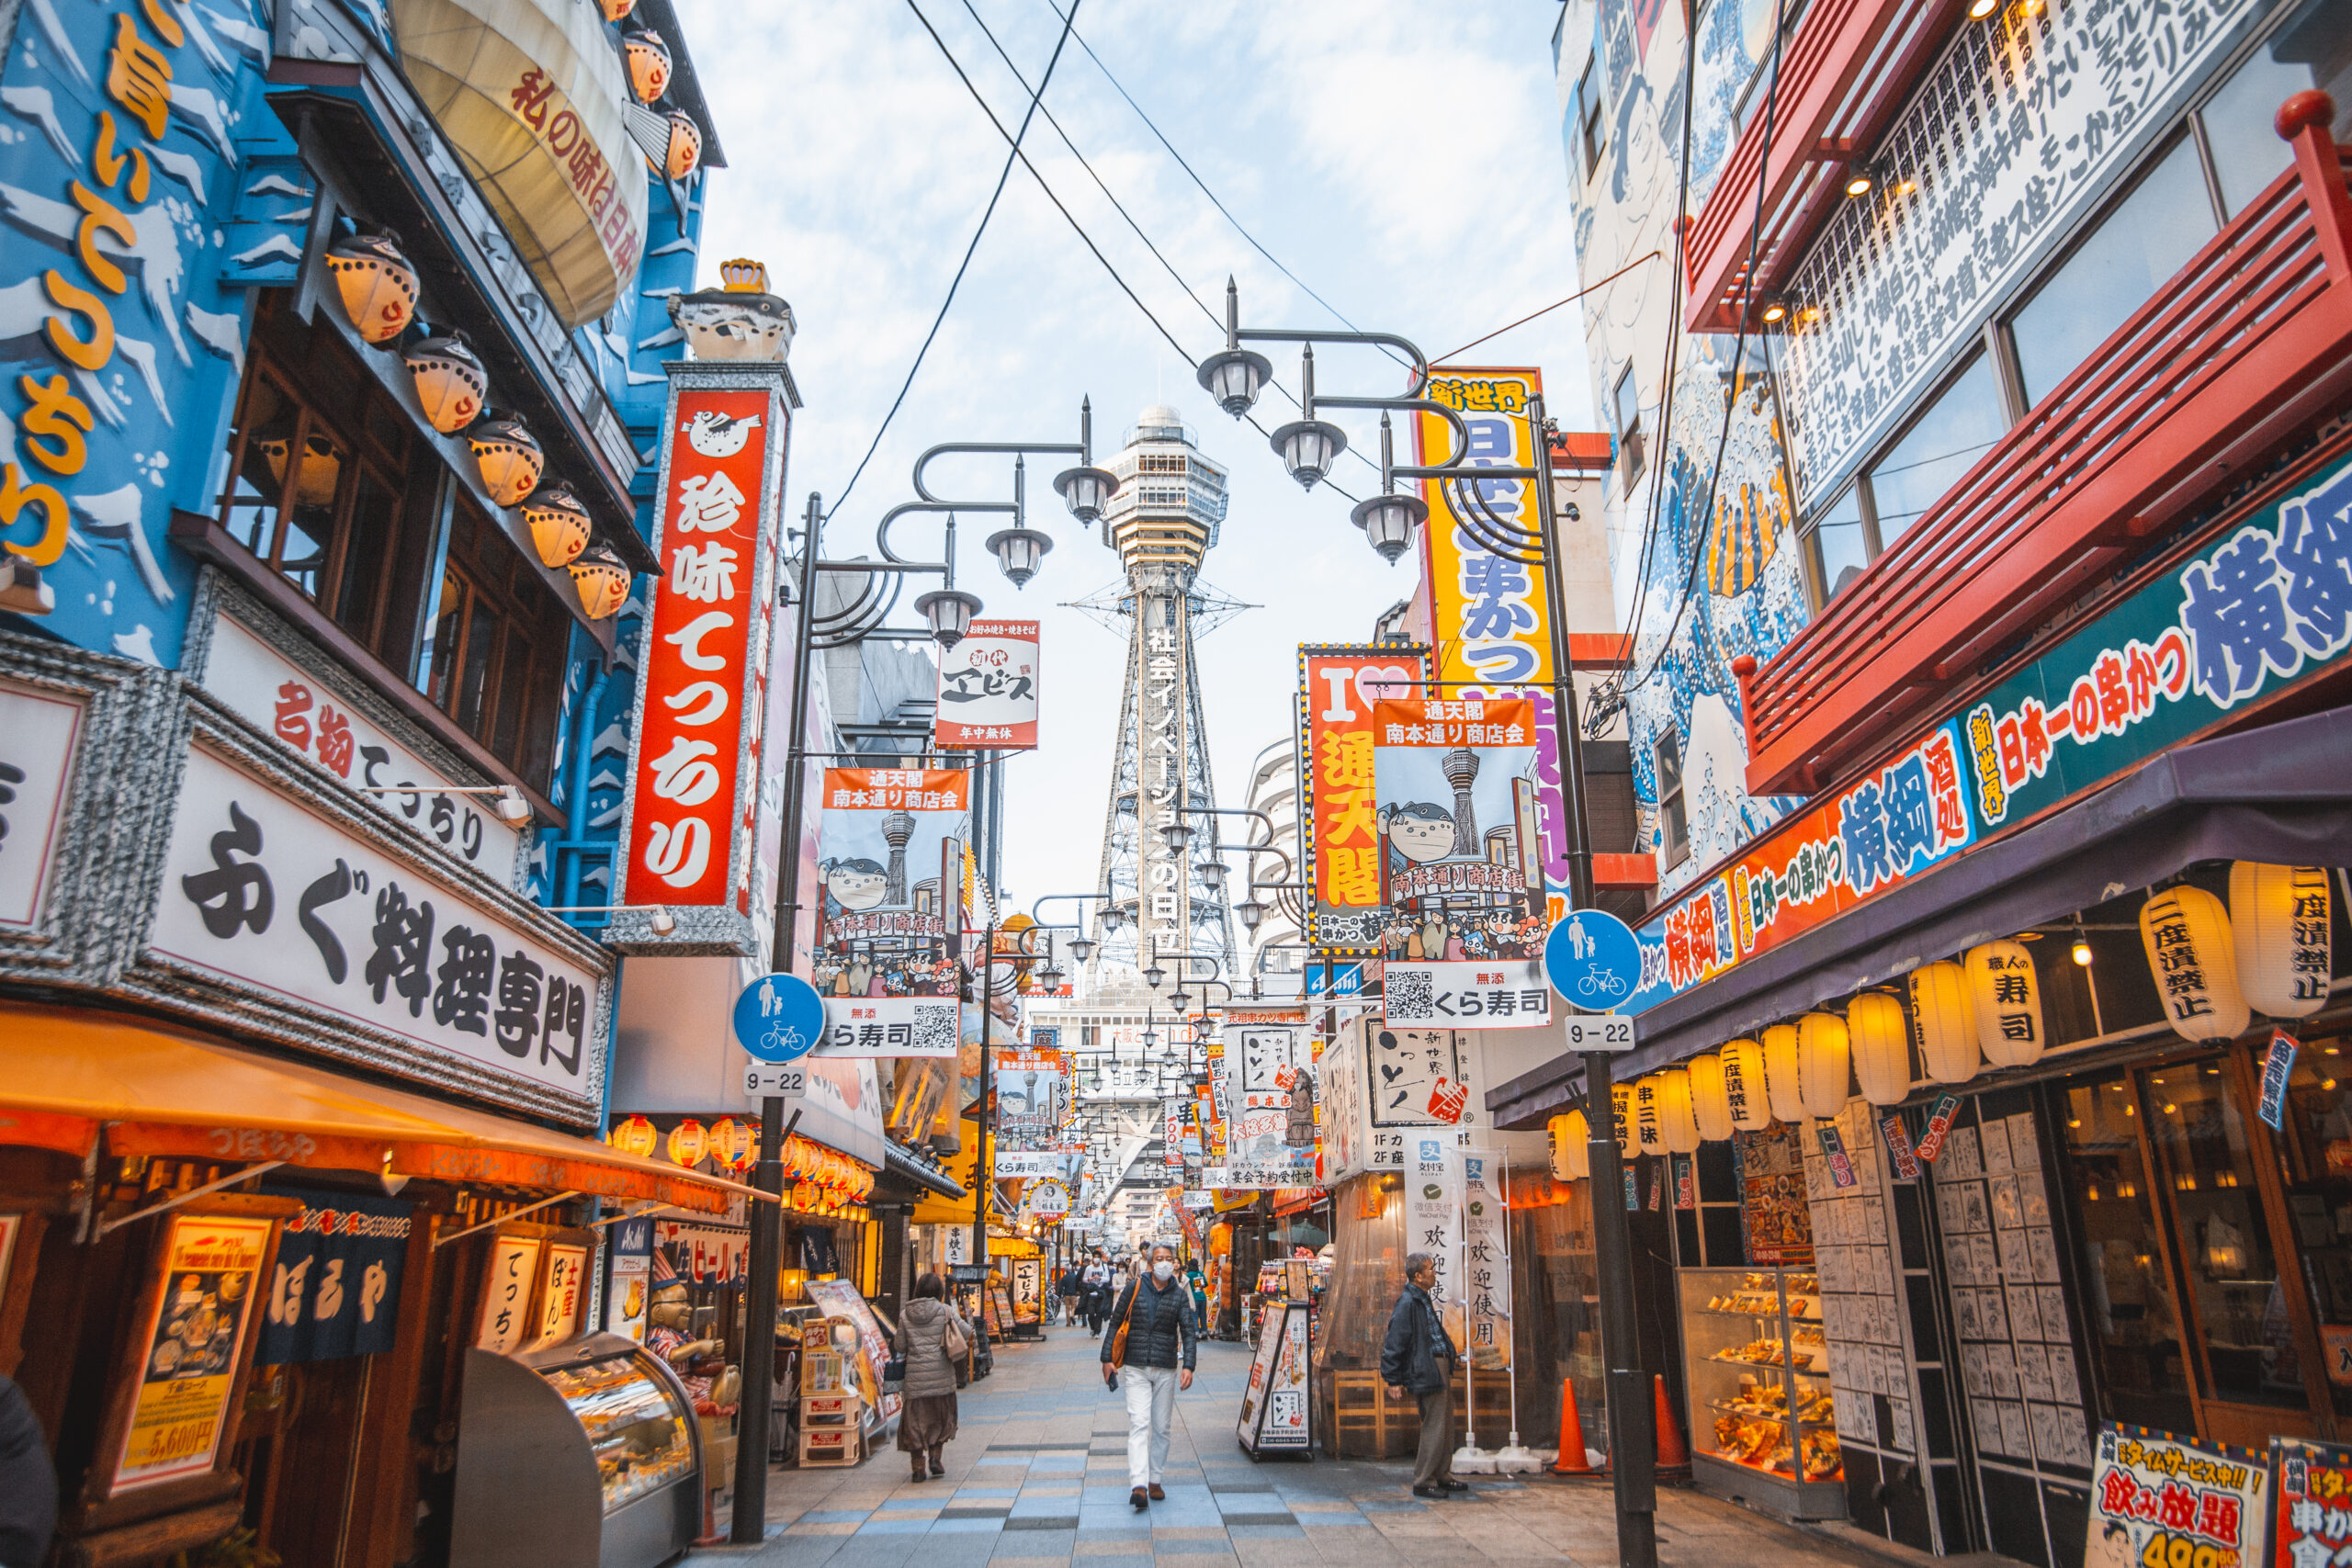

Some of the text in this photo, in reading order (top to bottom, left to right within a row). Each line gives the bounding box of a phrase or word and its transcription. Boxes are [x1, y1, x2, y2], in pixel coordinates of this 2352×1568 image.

[2043, 47, 2088, 188] たこ
[2064, 20, 2111, 164] いか
[2007, 95, 2050, 231] 貝柱
[2024, 71, 2067, 210] サーモン
[1957, 163, 1995, 293] かぼちゃ
[1973, 141, 2012, 276] 海老
[1991, 118, 2030, 251] キス
[1915, 223, 1946, 345] じゃが芋
[1928, 204, 1962, 328] 茄子
[1943, 186, 1977, 310] 椎茸
[1874, 277, 1904, 392] 銀杏
[1887, 261, 1917, 378] 白ねぎ
[1900, 242, 1932, 362] さつま芋
[1838, 325, 1865, 434] 山芋
[1850, 310, 1878, 420] しし唐
[1862, 294, 1891, 406] れんこん
[1430, 379, 1528, 413] 新世界
[1796, 384, 1820, 484] うずら玉子
[1806, 370, 1831, 472] 紅しょうが
[1817, 358, 1842, 461] にんにく
[1827, 341, 1852, 447] 玉ねぎ
[941, 668, 1035, 703] エビス
[1424, 701, 1484, 720] 通天閣
[1972, 709, 2006, 819] 新世界
[1997, 632, 2187, 788] 日本一の串かつ
[959, 727, 1012, 739] 年中無休
[1385, 723, 1524, 744] 南本通り商店会
[833, 789, 957, 808] 南本通り商店会
[869, 770, 923, 787] 通天閣
[1394, 867, 1525, 892] 南本通り商店街
[1736, 728, 1967, 950] 新世界 日本一の串かつ 横綱 酒処
[181, 800, 588, 1077] ふぐ料理専門
[829, 913, 944, 936] 南本通り商店街
[1320, 917, 1359, 926] 日本一の
[1320, 928, 1359, 941] 串かつ
[1665, 891, 1717, 987] 横綱
[1987, 955, 2029, 971] 職人の
[2148, 899, 2215, 1021] 二度漬禁止
[2291, 866, 2330, 1002] 二度漬禁止
[851, 1009, 876, 1019] 無添
[1227, 1012, 1306, 1023] 元祖串カツ専門店
[1434, 988, 1548, 1017] くら寿司
[1476, 973, 1505, 985] 無添
[1996, 975, 2034, 1043] 寿司
[1425, 1032, 1445, 1075] 新世界
[1723, 1048, 1748, 1122] 二度漬禁止
[996, 1162, 1038, 1173] くら寿司
[1231, 1113, 1288, 1141] 大阪名物
[1418, 1162, 1444, 1172] 支付宝
[1232, 1169, 1313, 1184] 宴会予約受付中
[1414, 1202, 1453, 1213] 微信支付
[948, 1227, 962, 1260] 串焼き
[1017, 1264, 1033, 1303] エビス
[1470, 1240, 1496, 1346] 欢迎使用
[2100, 1469, 2240, 1547] 飲み放題
